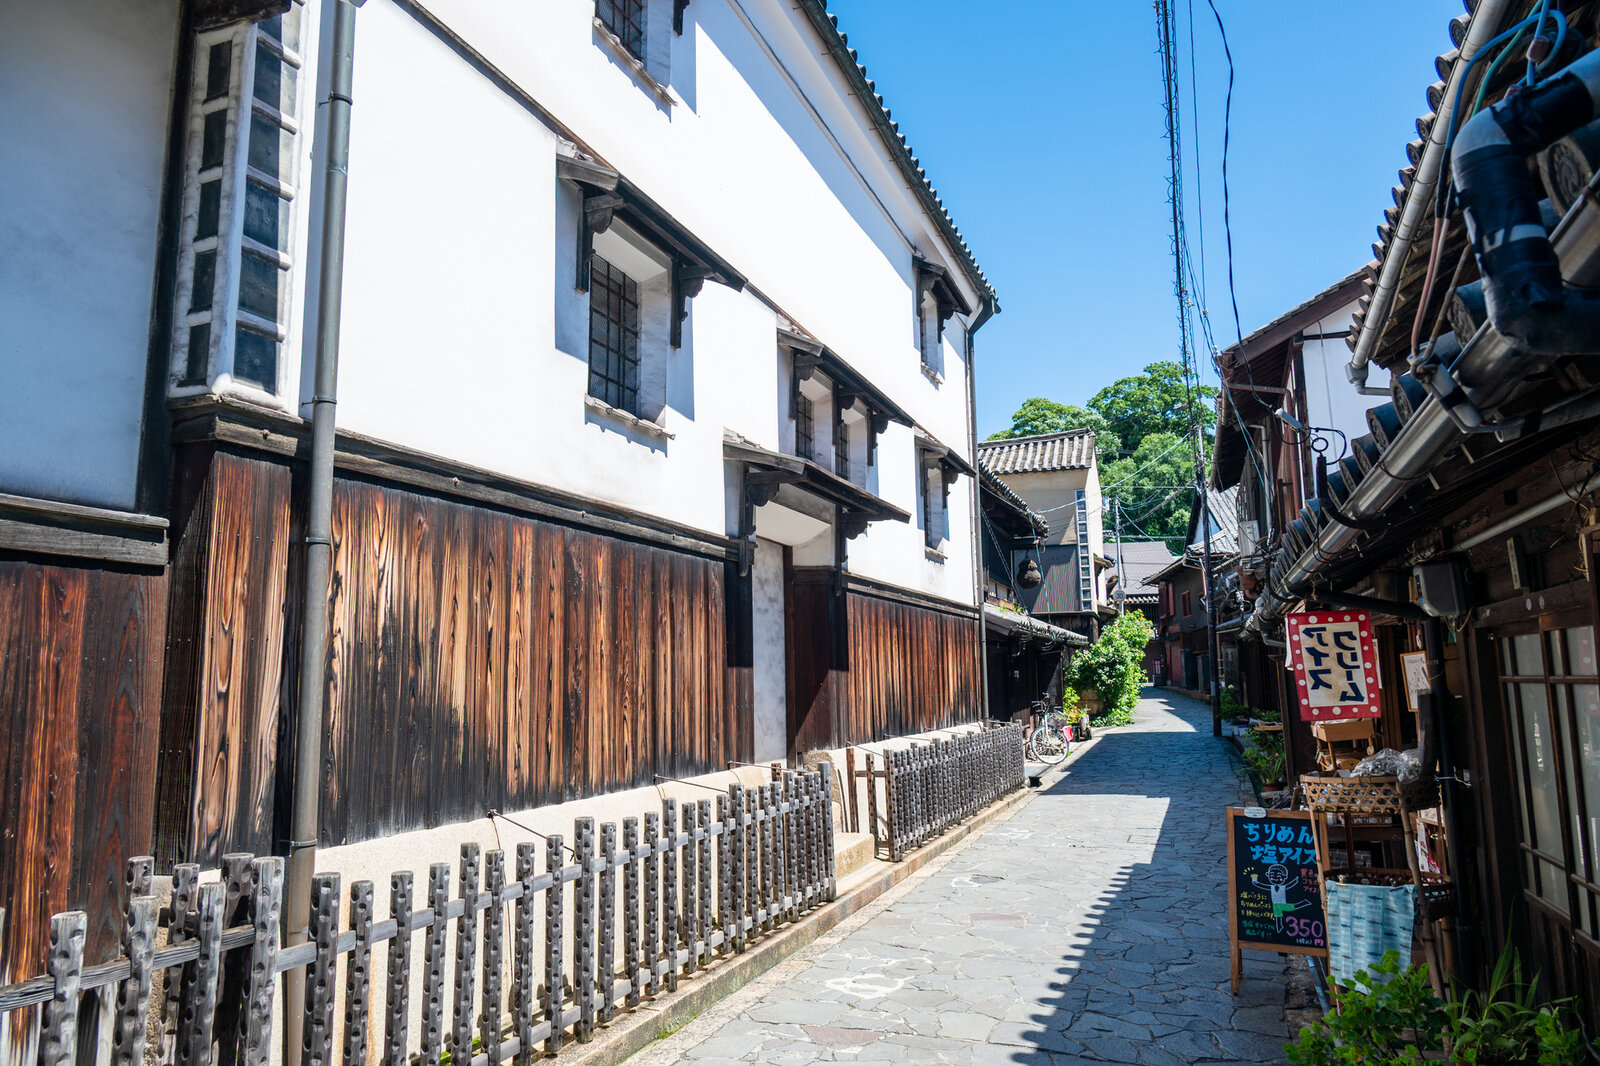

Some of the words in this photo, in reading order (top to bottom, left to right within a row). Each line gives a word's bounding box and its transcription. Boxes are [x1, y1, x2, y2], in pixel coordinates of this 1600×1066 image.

[1242, 823, 1314, 844] ちりめん
[1250, 843, 1318, 865] 塩アイス
[1285, 916, 1324, 938] 350
[1314, 938, 1324, 946] 円
